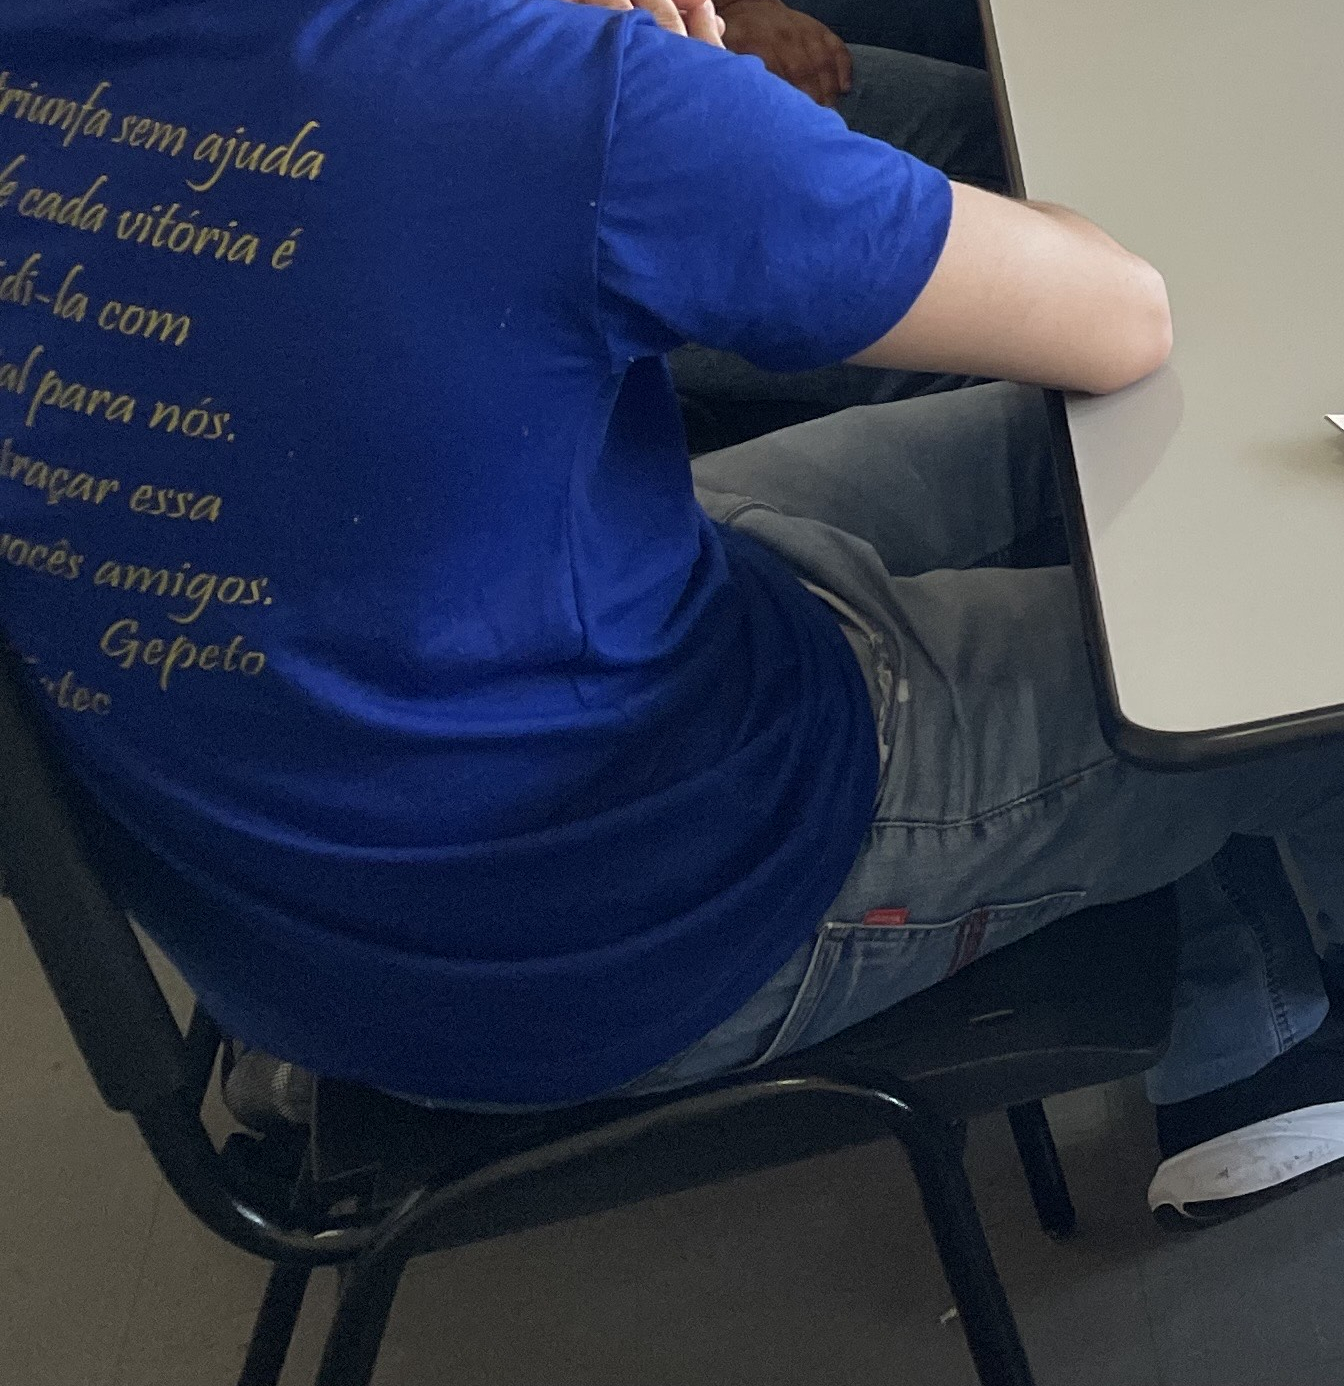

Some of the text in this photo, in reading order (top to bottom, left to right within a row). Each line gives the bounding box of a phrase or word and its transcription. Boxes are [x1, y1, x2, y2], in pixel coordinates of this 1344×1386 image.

[112, 114, 188, 157] sem
[186, 120, 326, 192] ajuda
[18, 175, 109, 234] cada
[116, 202, 260, 266] vitória
[271, 227, 304, 271] é
[0, 252, 192, 347] di-la com
[25, 369, 136, 428] para
[149, 396, 236, 443] nós.
[129, 482, 224, 523] essa
[93, 559, 274, 625] amigos.
[101, 618, 267, 691] Gepeto
